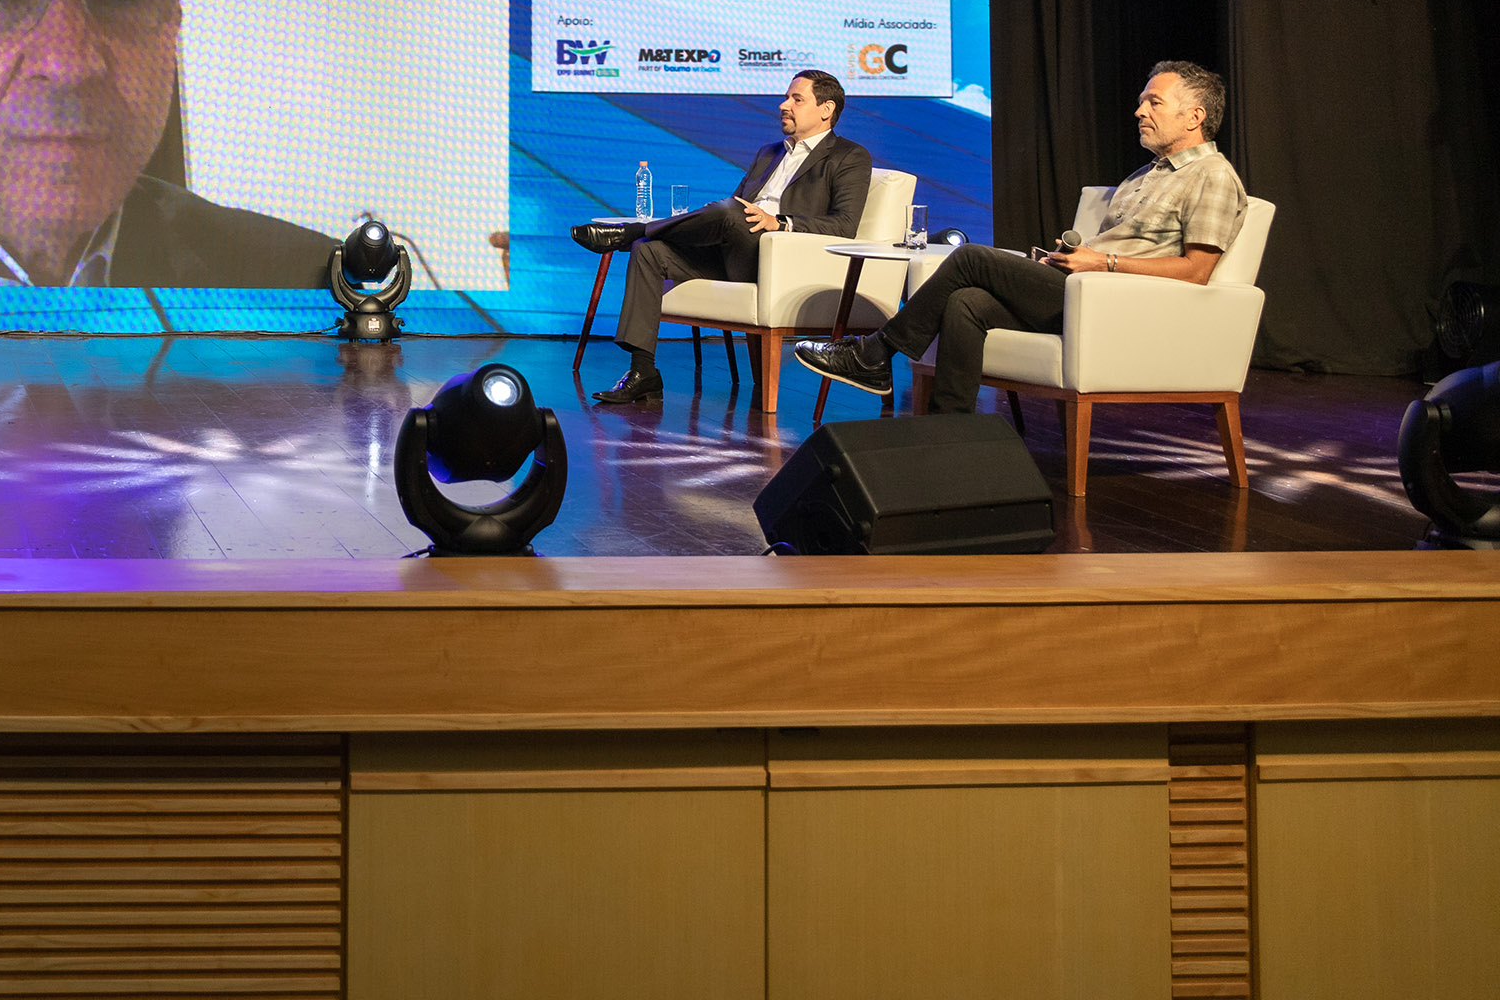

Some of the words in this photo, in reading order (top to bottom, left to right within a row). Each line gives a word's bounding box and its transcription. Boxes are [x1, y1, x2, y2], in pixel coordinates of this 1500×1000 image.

[557, 15, 594, 28] Apoio:
[844, 17, 875, 29] Mídia
[877, 18, 937, 30] Associada:
[556, 39, 610, 65] BW
[858, 43, 908, 74] GC
